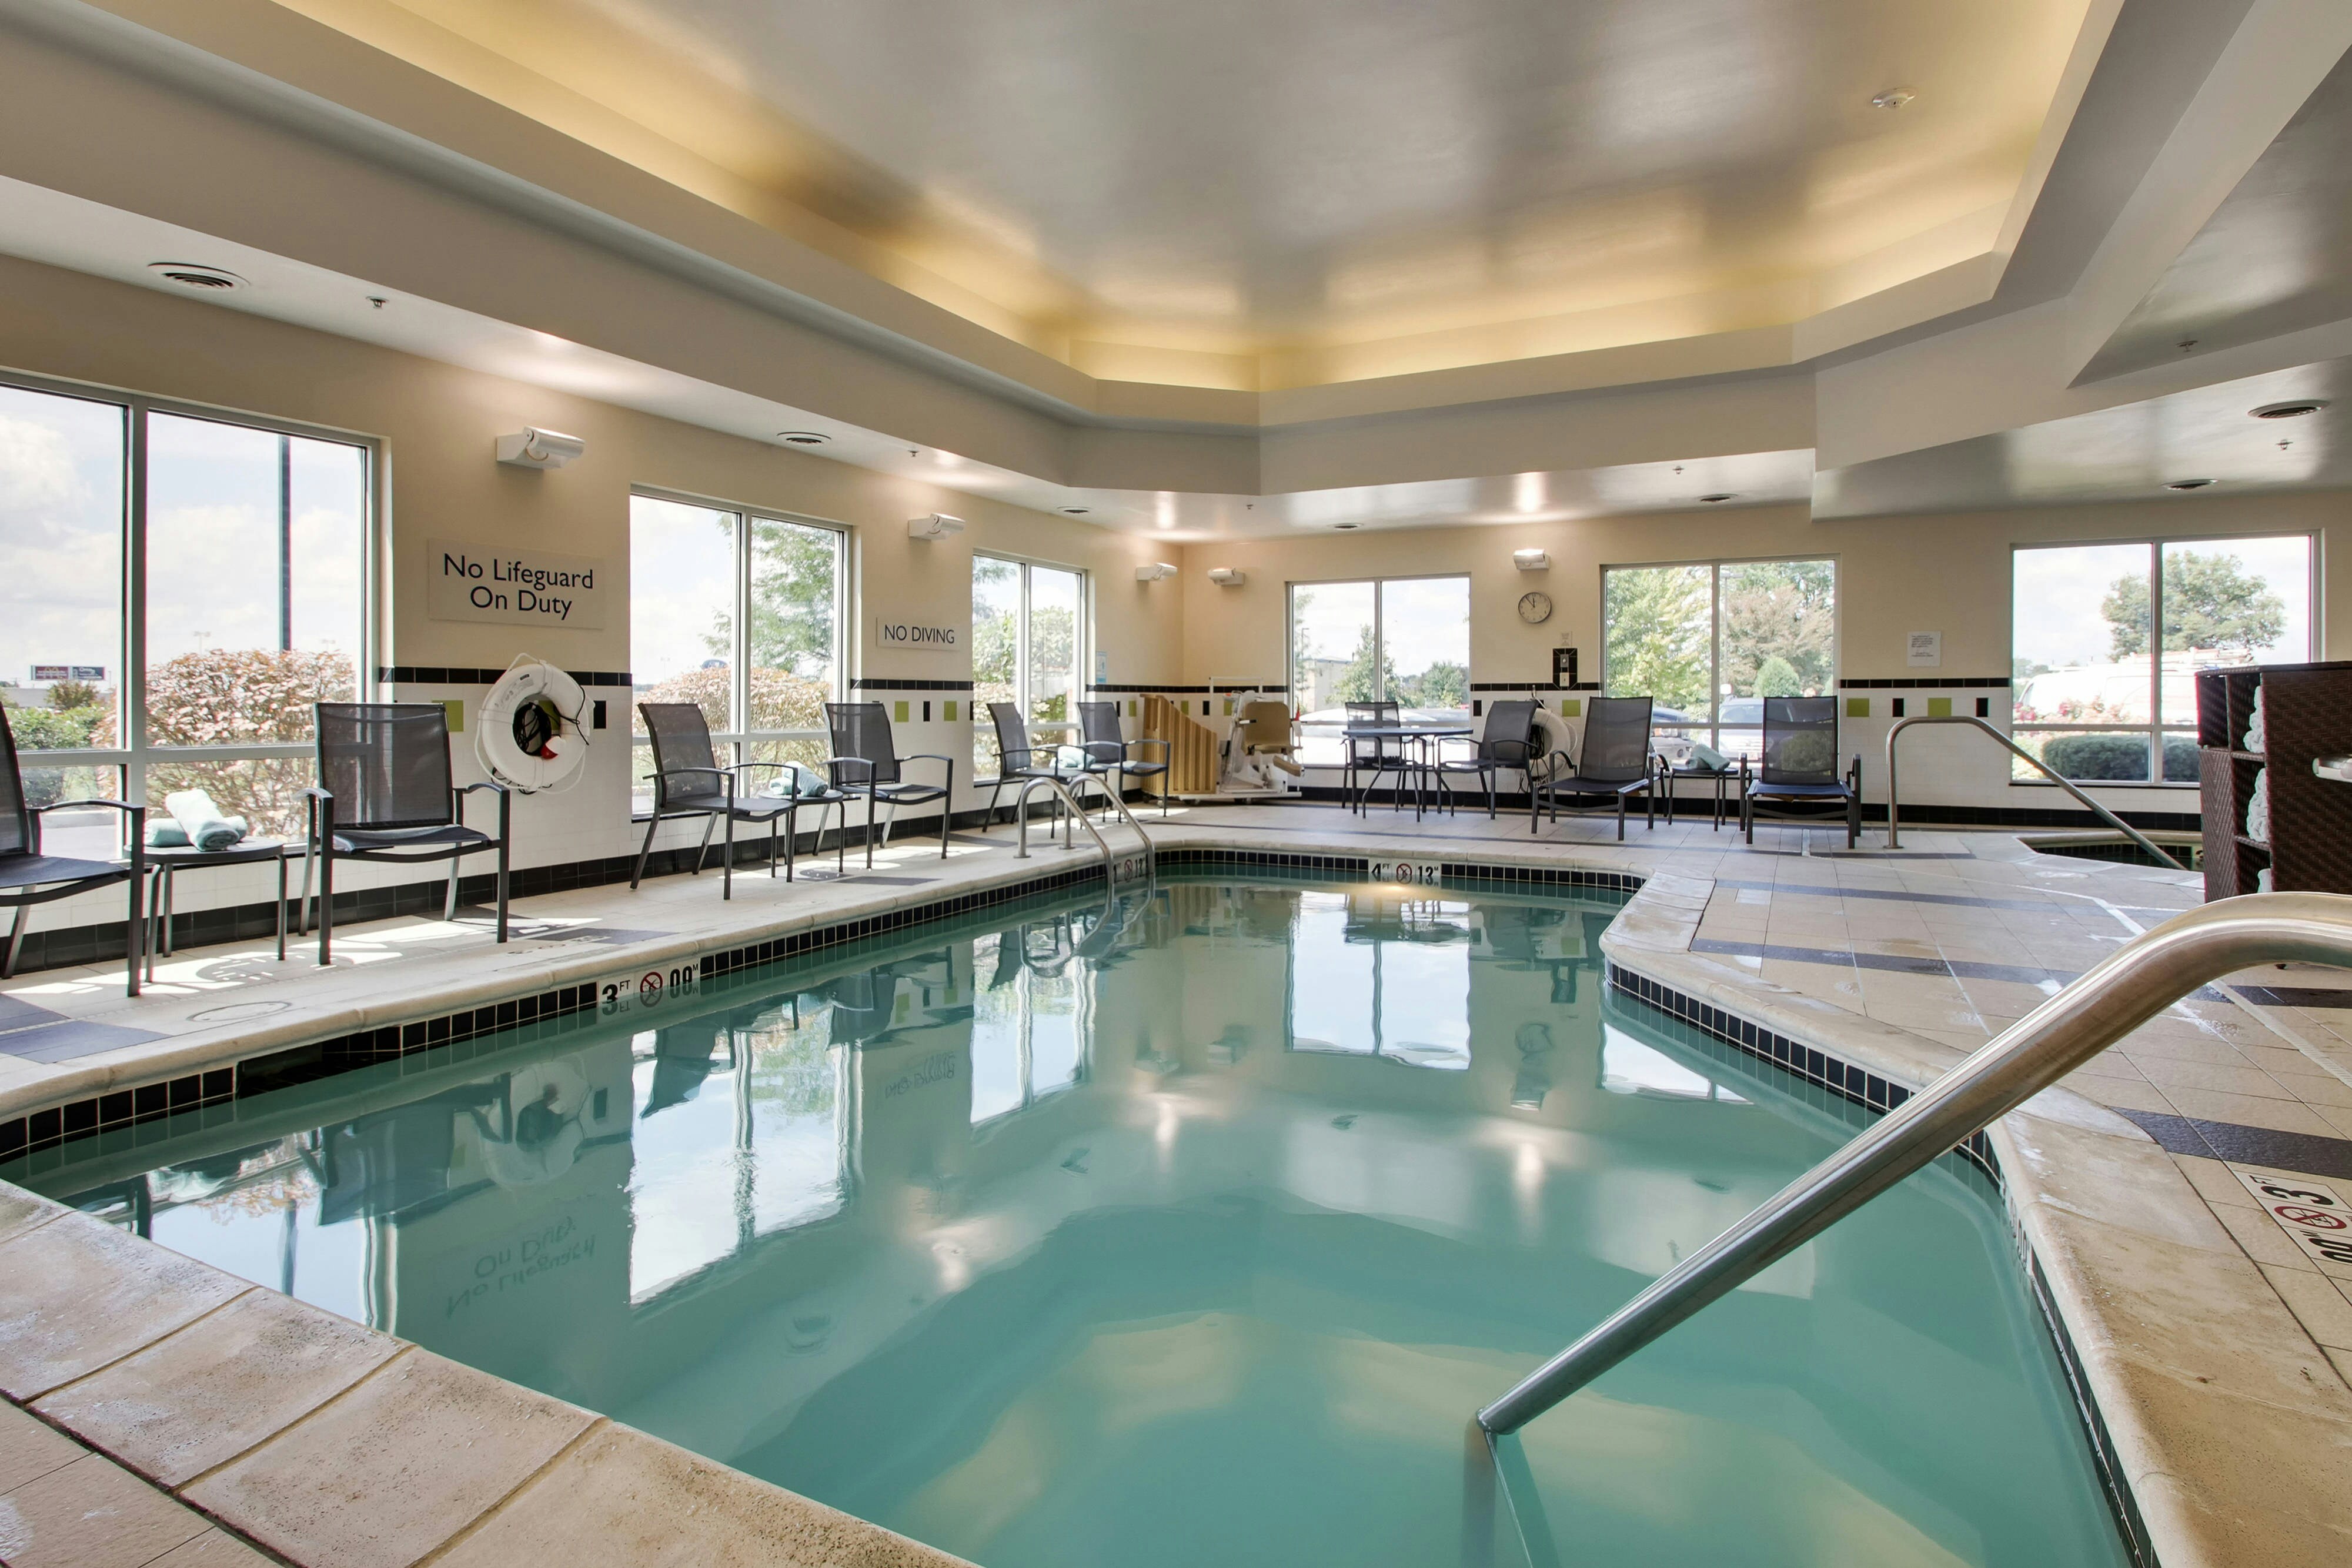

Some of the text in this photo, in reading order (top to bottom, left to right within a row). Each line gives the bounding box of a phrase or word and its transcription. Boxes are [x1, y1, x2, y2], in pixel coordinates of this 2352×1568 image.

[444, 553, 593, 591] No Lifeguard
[470, 586, 572, 620] On Duty
[884, 624, 954, 644] NO DIVING
[619, 979, 631, 991] FT
[2260, 1186, 2334, 1205] 3
